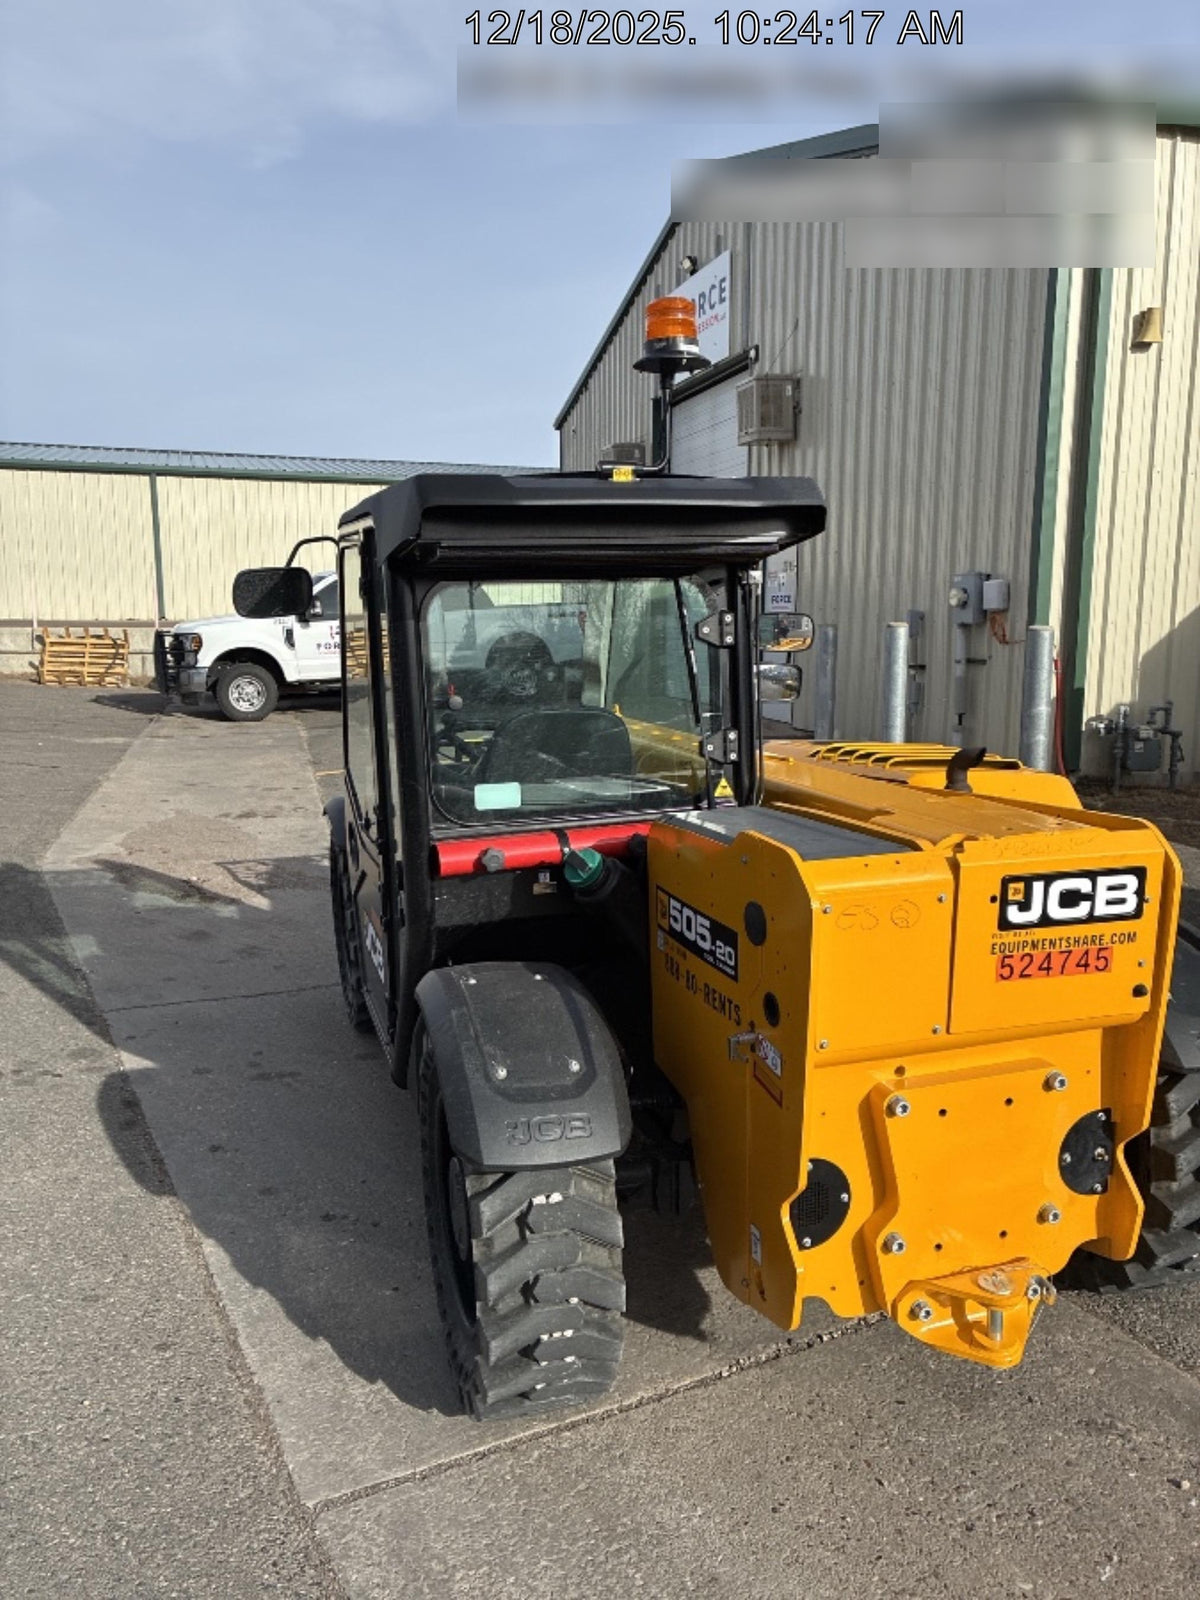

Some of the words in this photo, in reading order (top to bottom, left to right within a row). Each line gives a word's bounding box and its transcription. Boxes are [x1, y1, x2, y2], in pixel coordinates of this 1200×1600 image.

[692, 276, 727, 318] RCE
[1006, 874, 1140, 924] JCB
[990, 931, 1138, 955] EQUIPMENTSHARE.COM
[998, 947, 1111, 981] 524745
[509, 1112, 593, 1146] JCB
